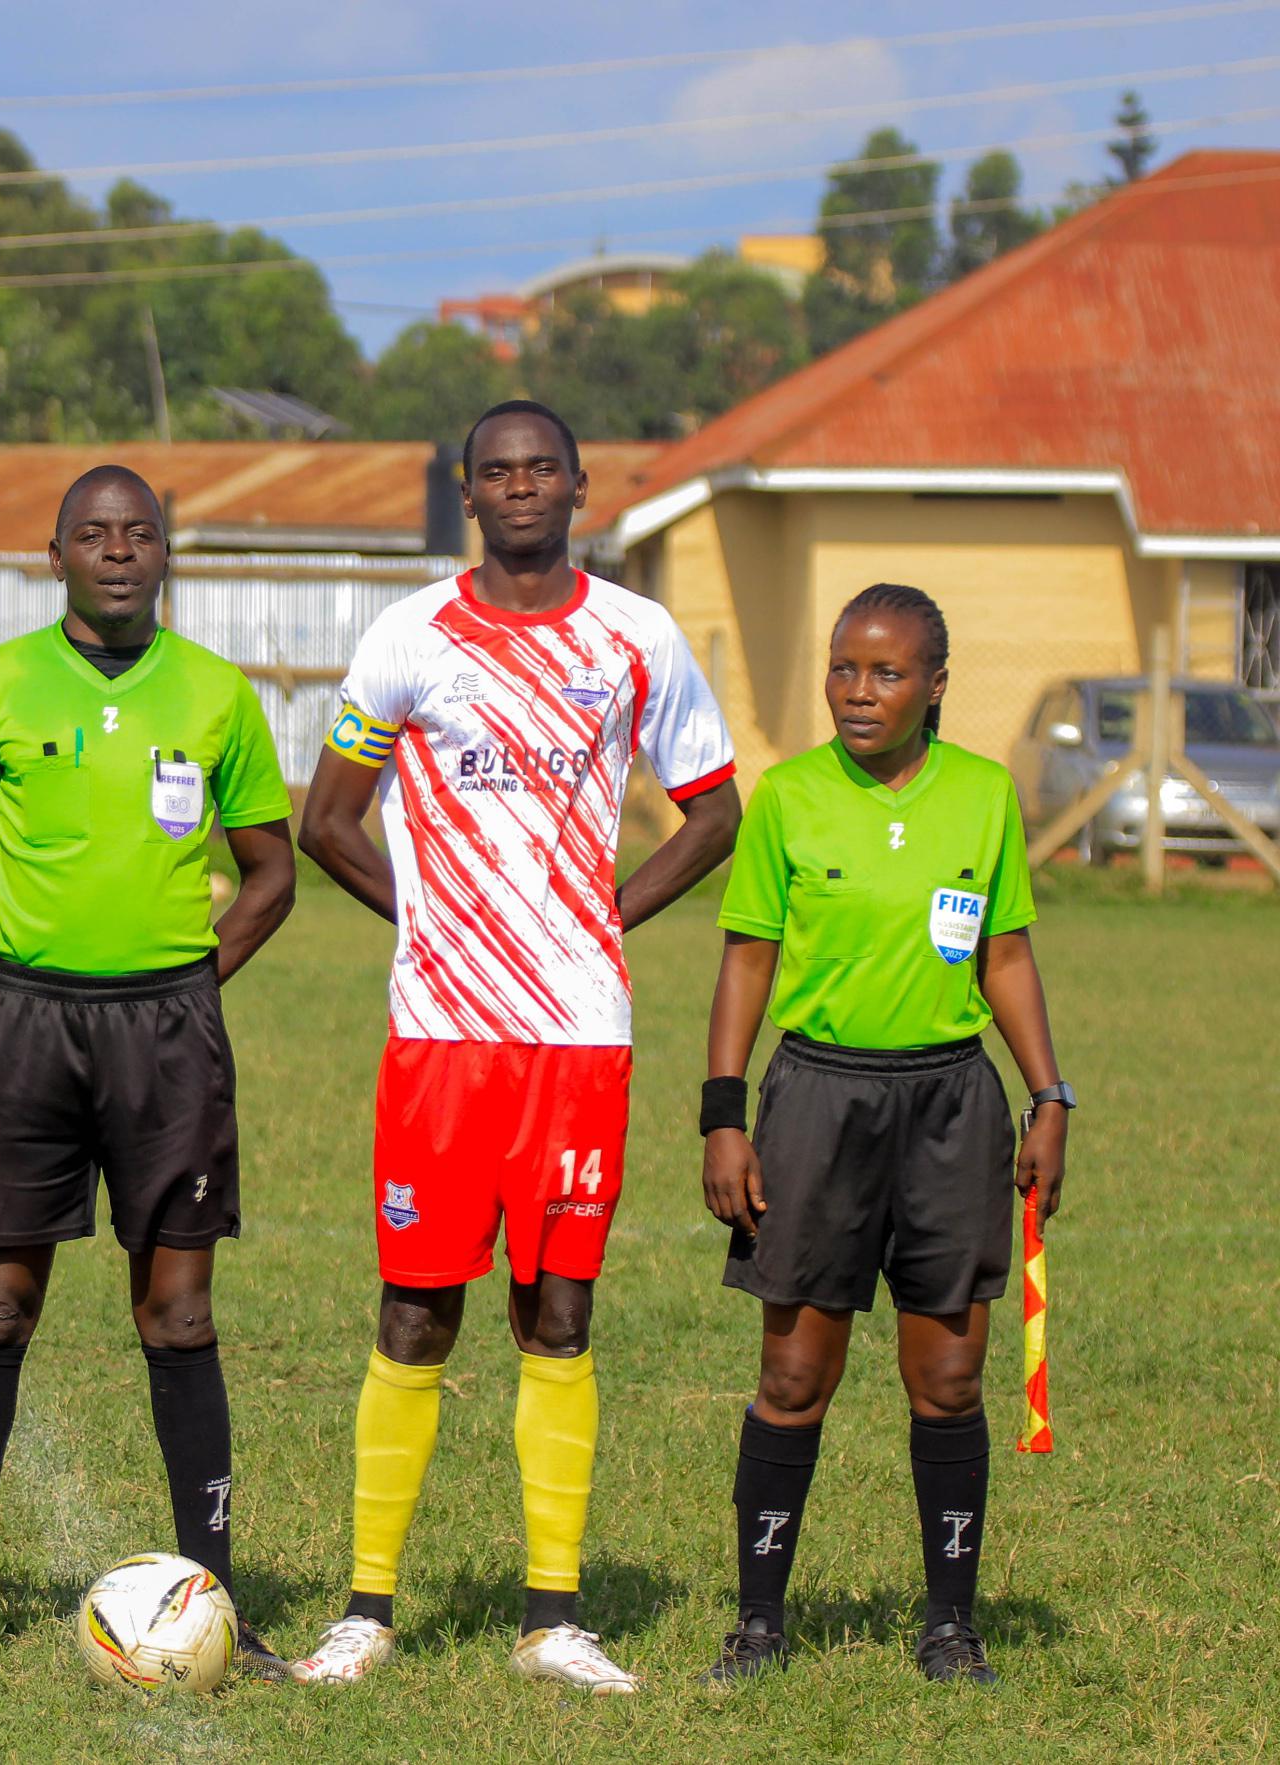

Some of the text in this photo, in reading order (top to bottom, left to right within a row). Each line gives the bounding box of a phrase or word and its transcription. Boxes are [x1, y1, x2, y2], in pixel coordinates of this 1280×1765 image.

[443, 693, 489, 704] GOFERE
[332, 712, 363, 749] C
[160, 773, 197, 787] REFEREE
[458, 778, 518, 793] BOARDING
[169, 824, 186, 835] 2025
[938, 893, 980, 918] FIFA
[944, 947, 965, 960] 2025
[560, 1148, 603, 1196] 14
[546, 1201, 606, 1218] GOFERE
